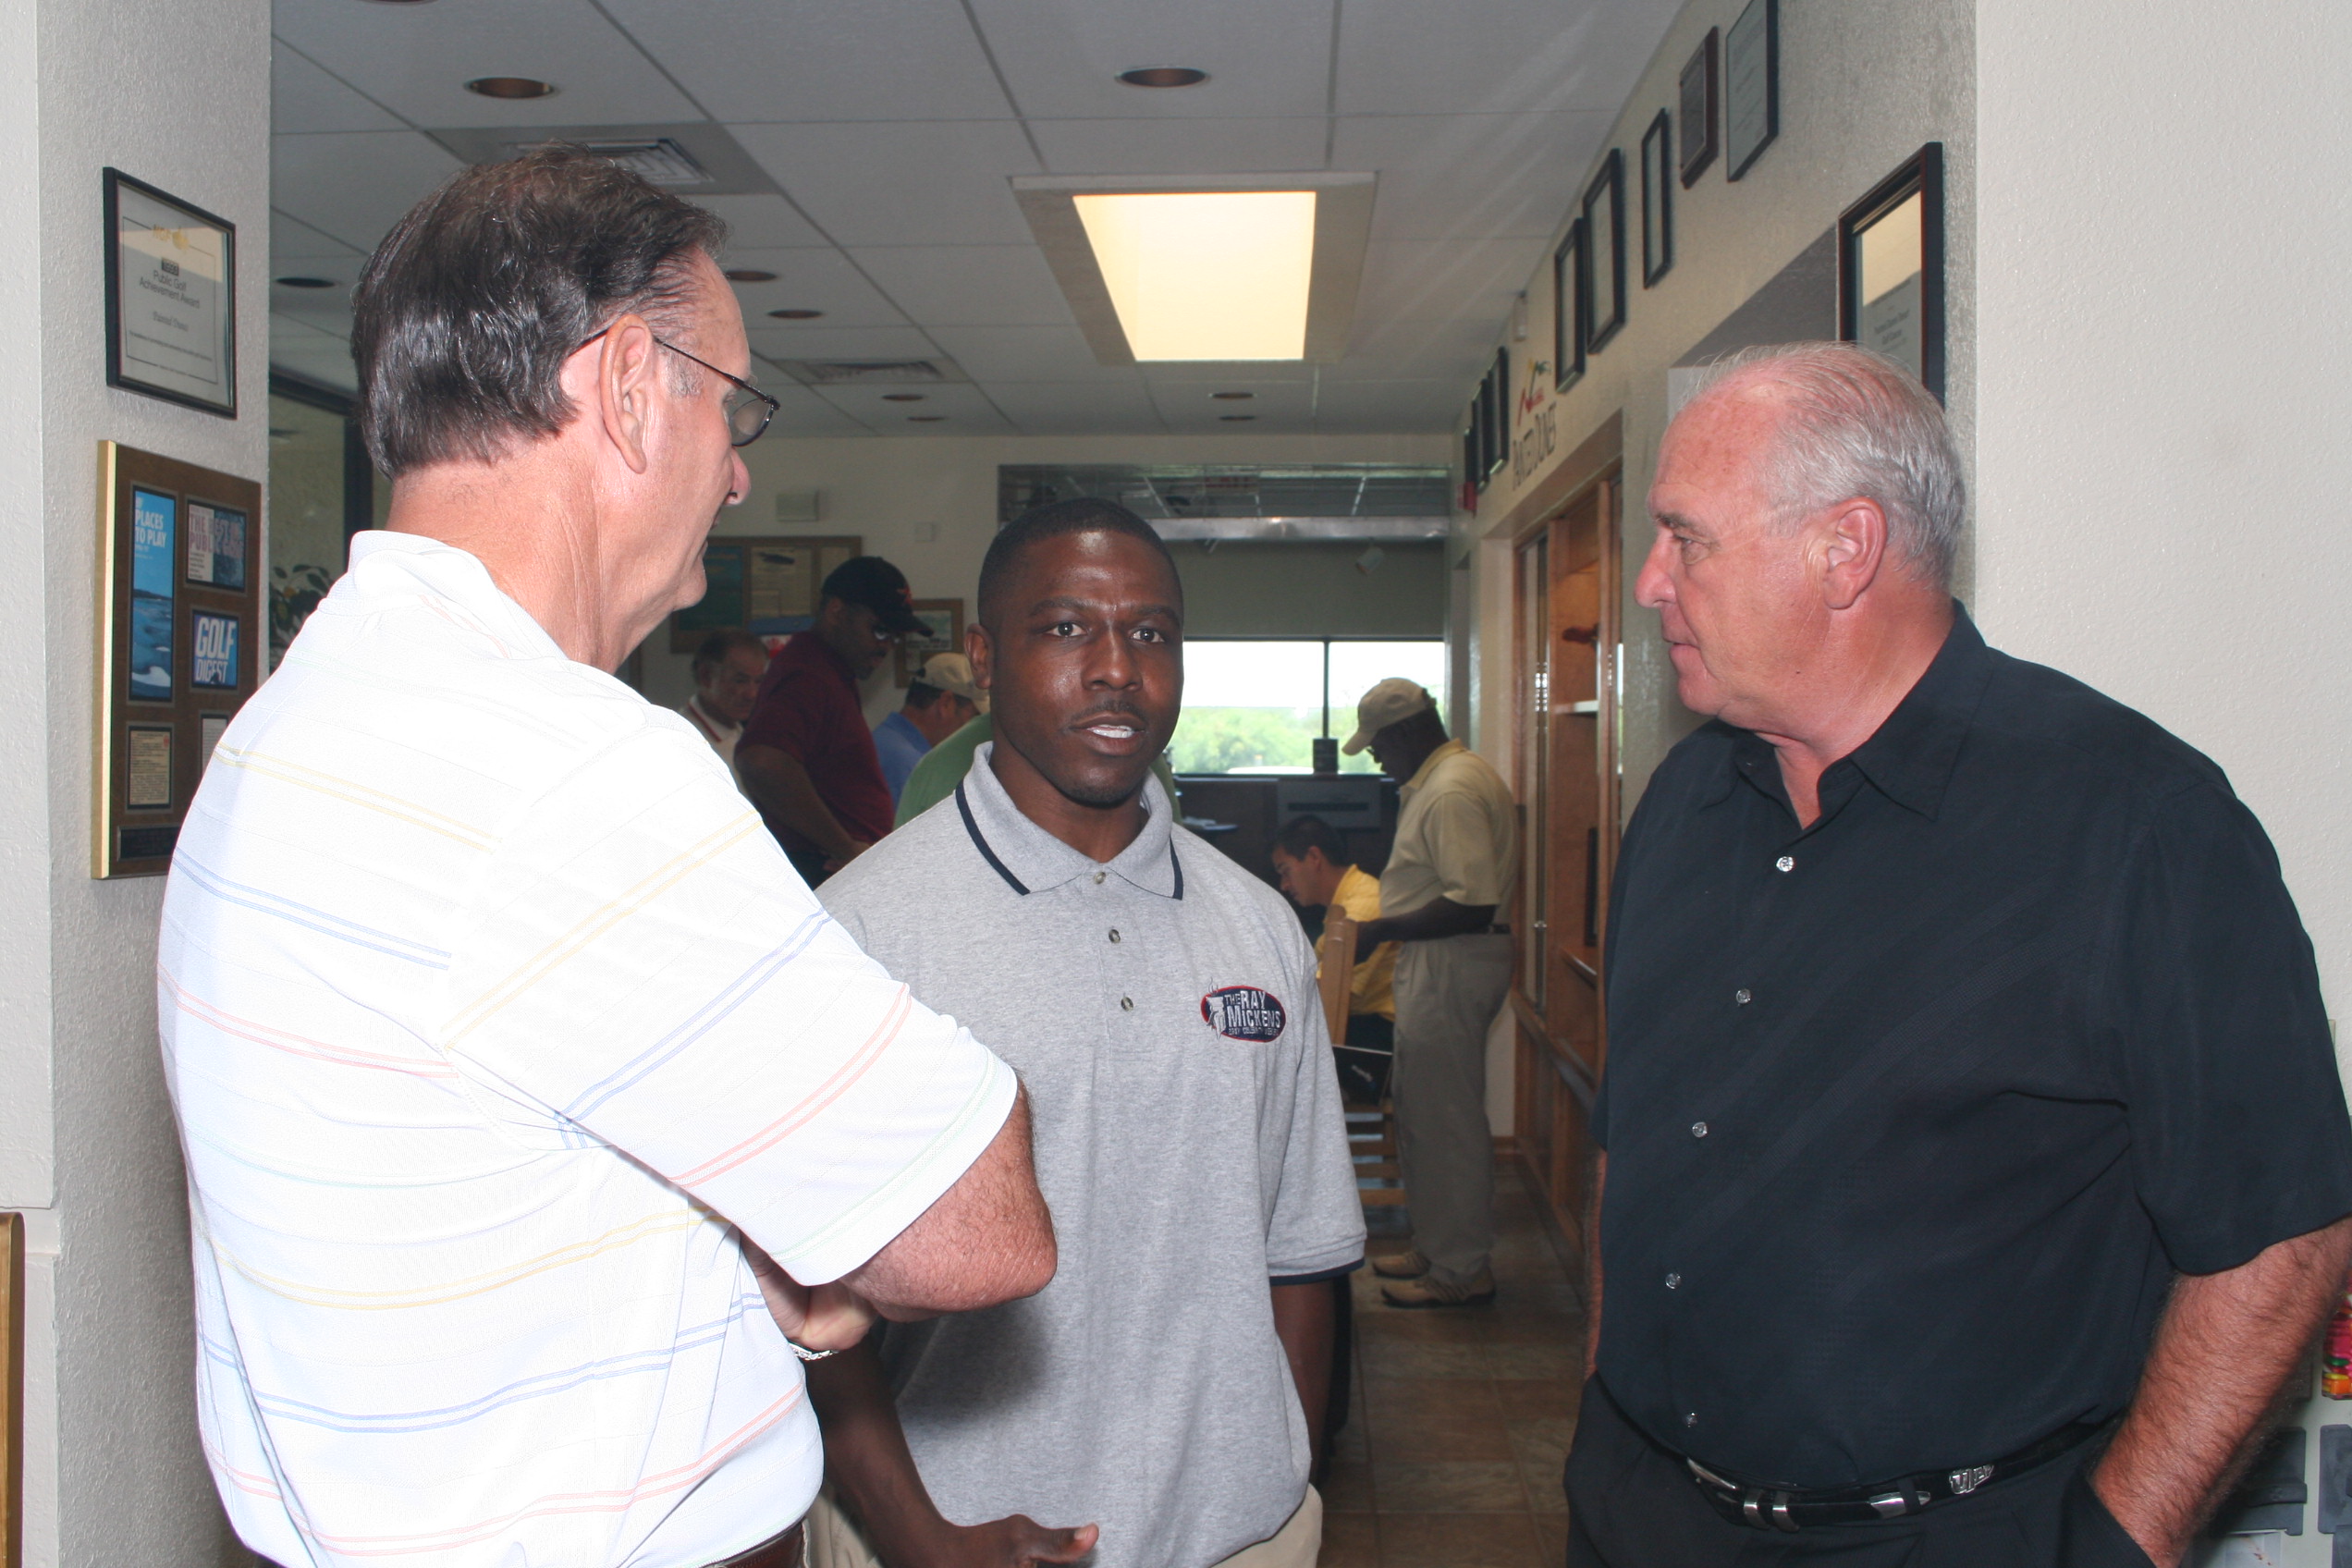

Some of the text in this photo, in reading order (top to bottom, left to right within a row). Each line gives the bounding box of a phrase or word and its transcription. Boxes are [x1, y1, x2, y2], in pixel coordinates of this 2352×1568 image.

[153, 270, 187, 291] Public Golf
[140, 276, 200, 309] Achievement Award
[135, 508, 164, 530] PLACES
[189, 513, 206, 533] THE
[135, 525, 146, 545] TO
[148, 529, 167, 548] PLAY
[195, 617, 237, 659] GOLF
[195, 658, 228, 683] DIGEST
[1224, 990, 1267, 1010] THE RAY
[1226, 1005, 1281, 1028] MICKENS
